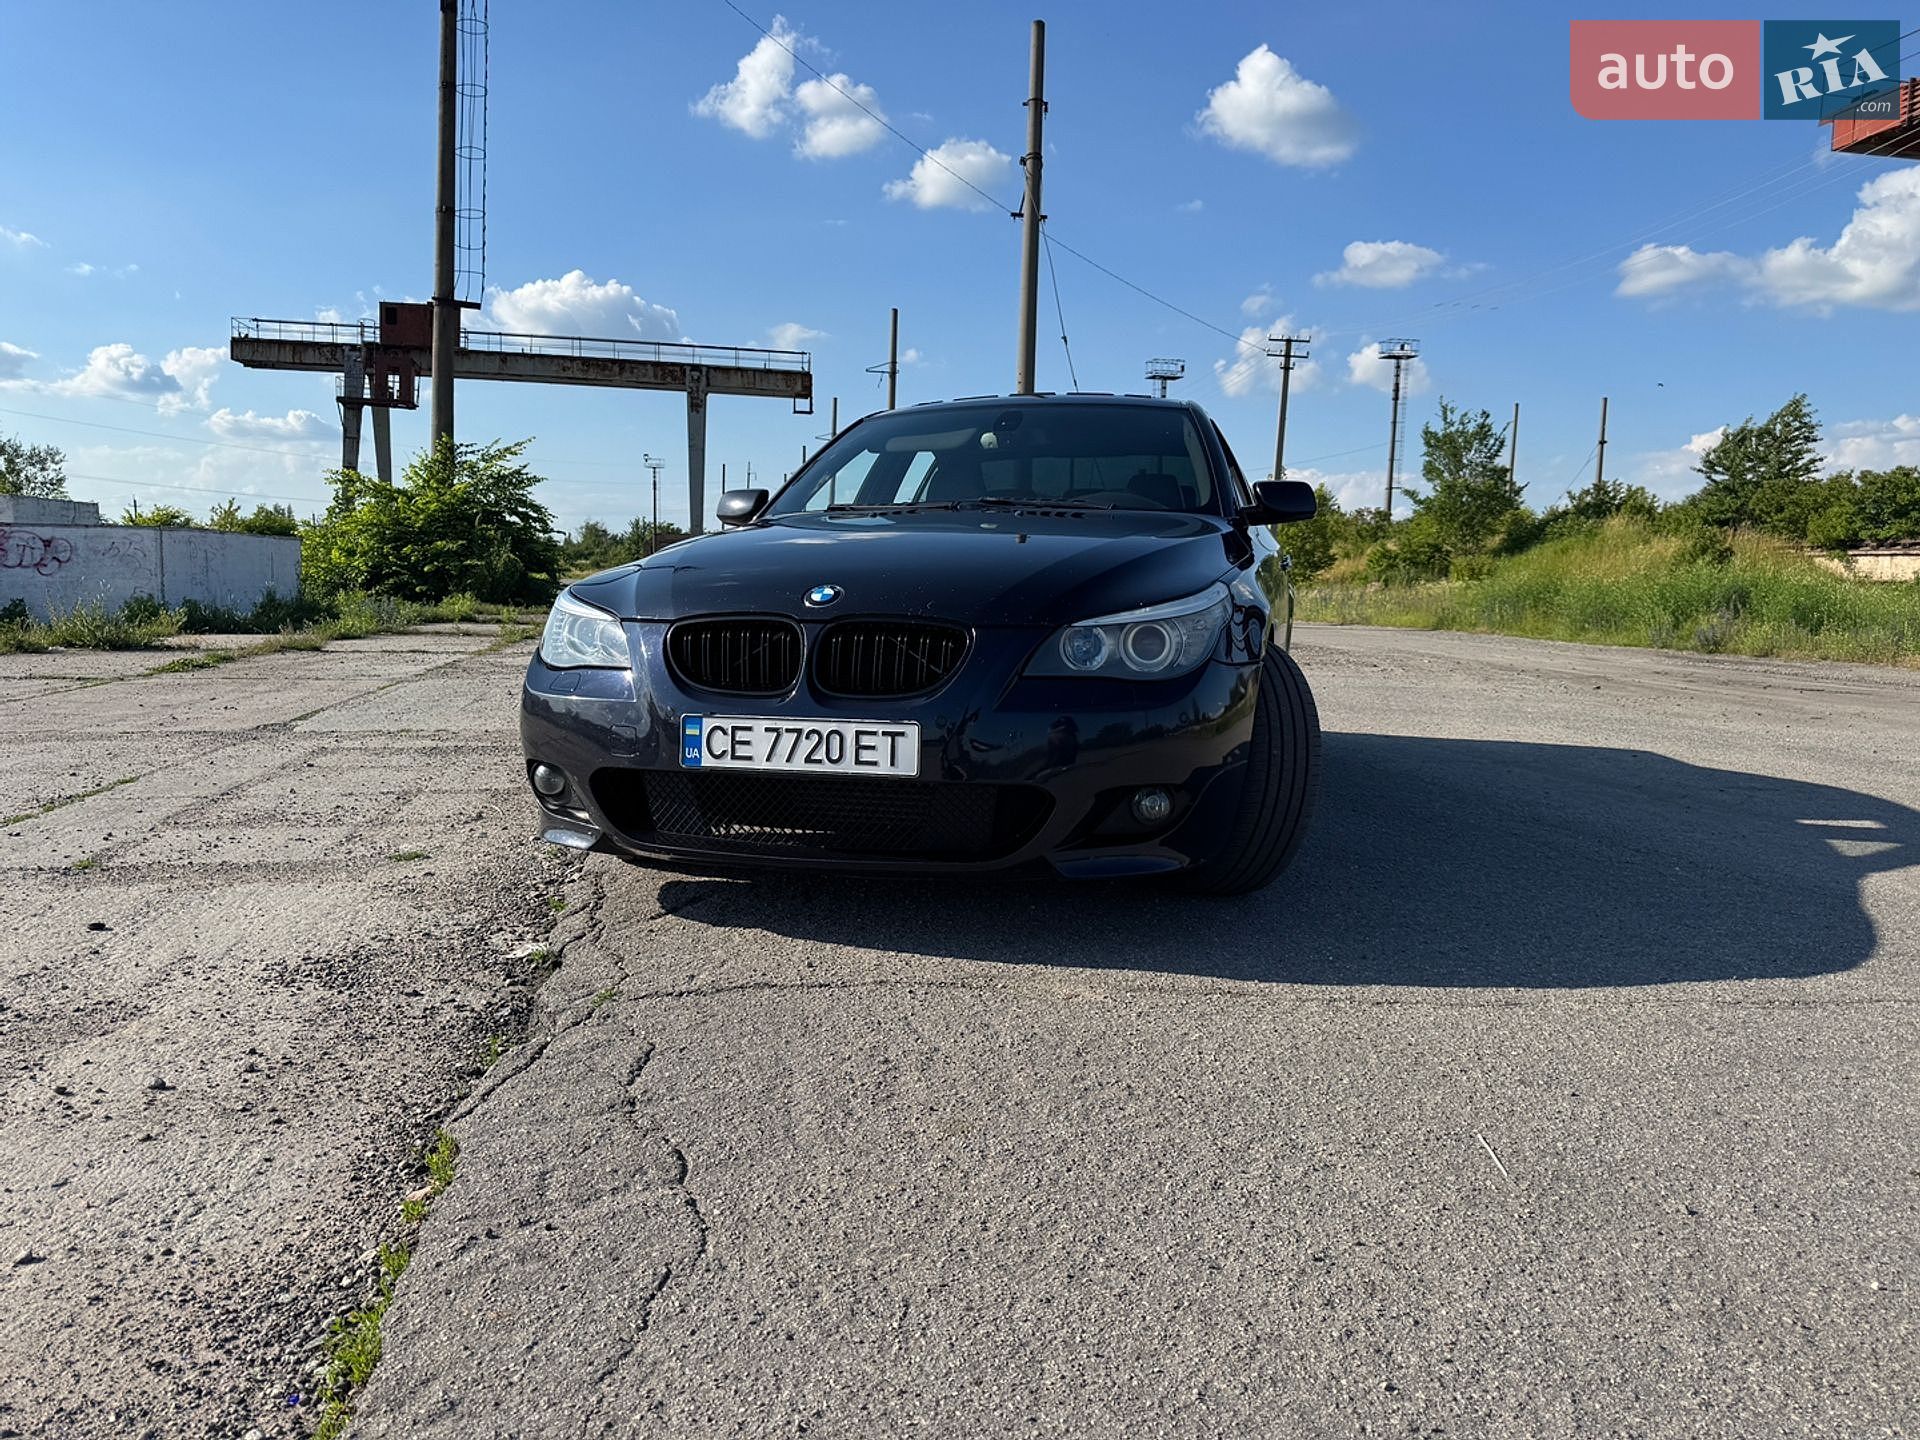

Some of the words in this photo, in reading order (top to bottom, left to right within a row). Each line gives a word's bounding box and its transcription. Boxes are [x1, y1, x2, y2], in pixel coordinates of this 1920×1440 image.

[685, 747, 700, 759] UA
[705, 725, 753, 761] CE
[764, 726, 844, 764] 7720
[854, 729, 905, 767] ET
